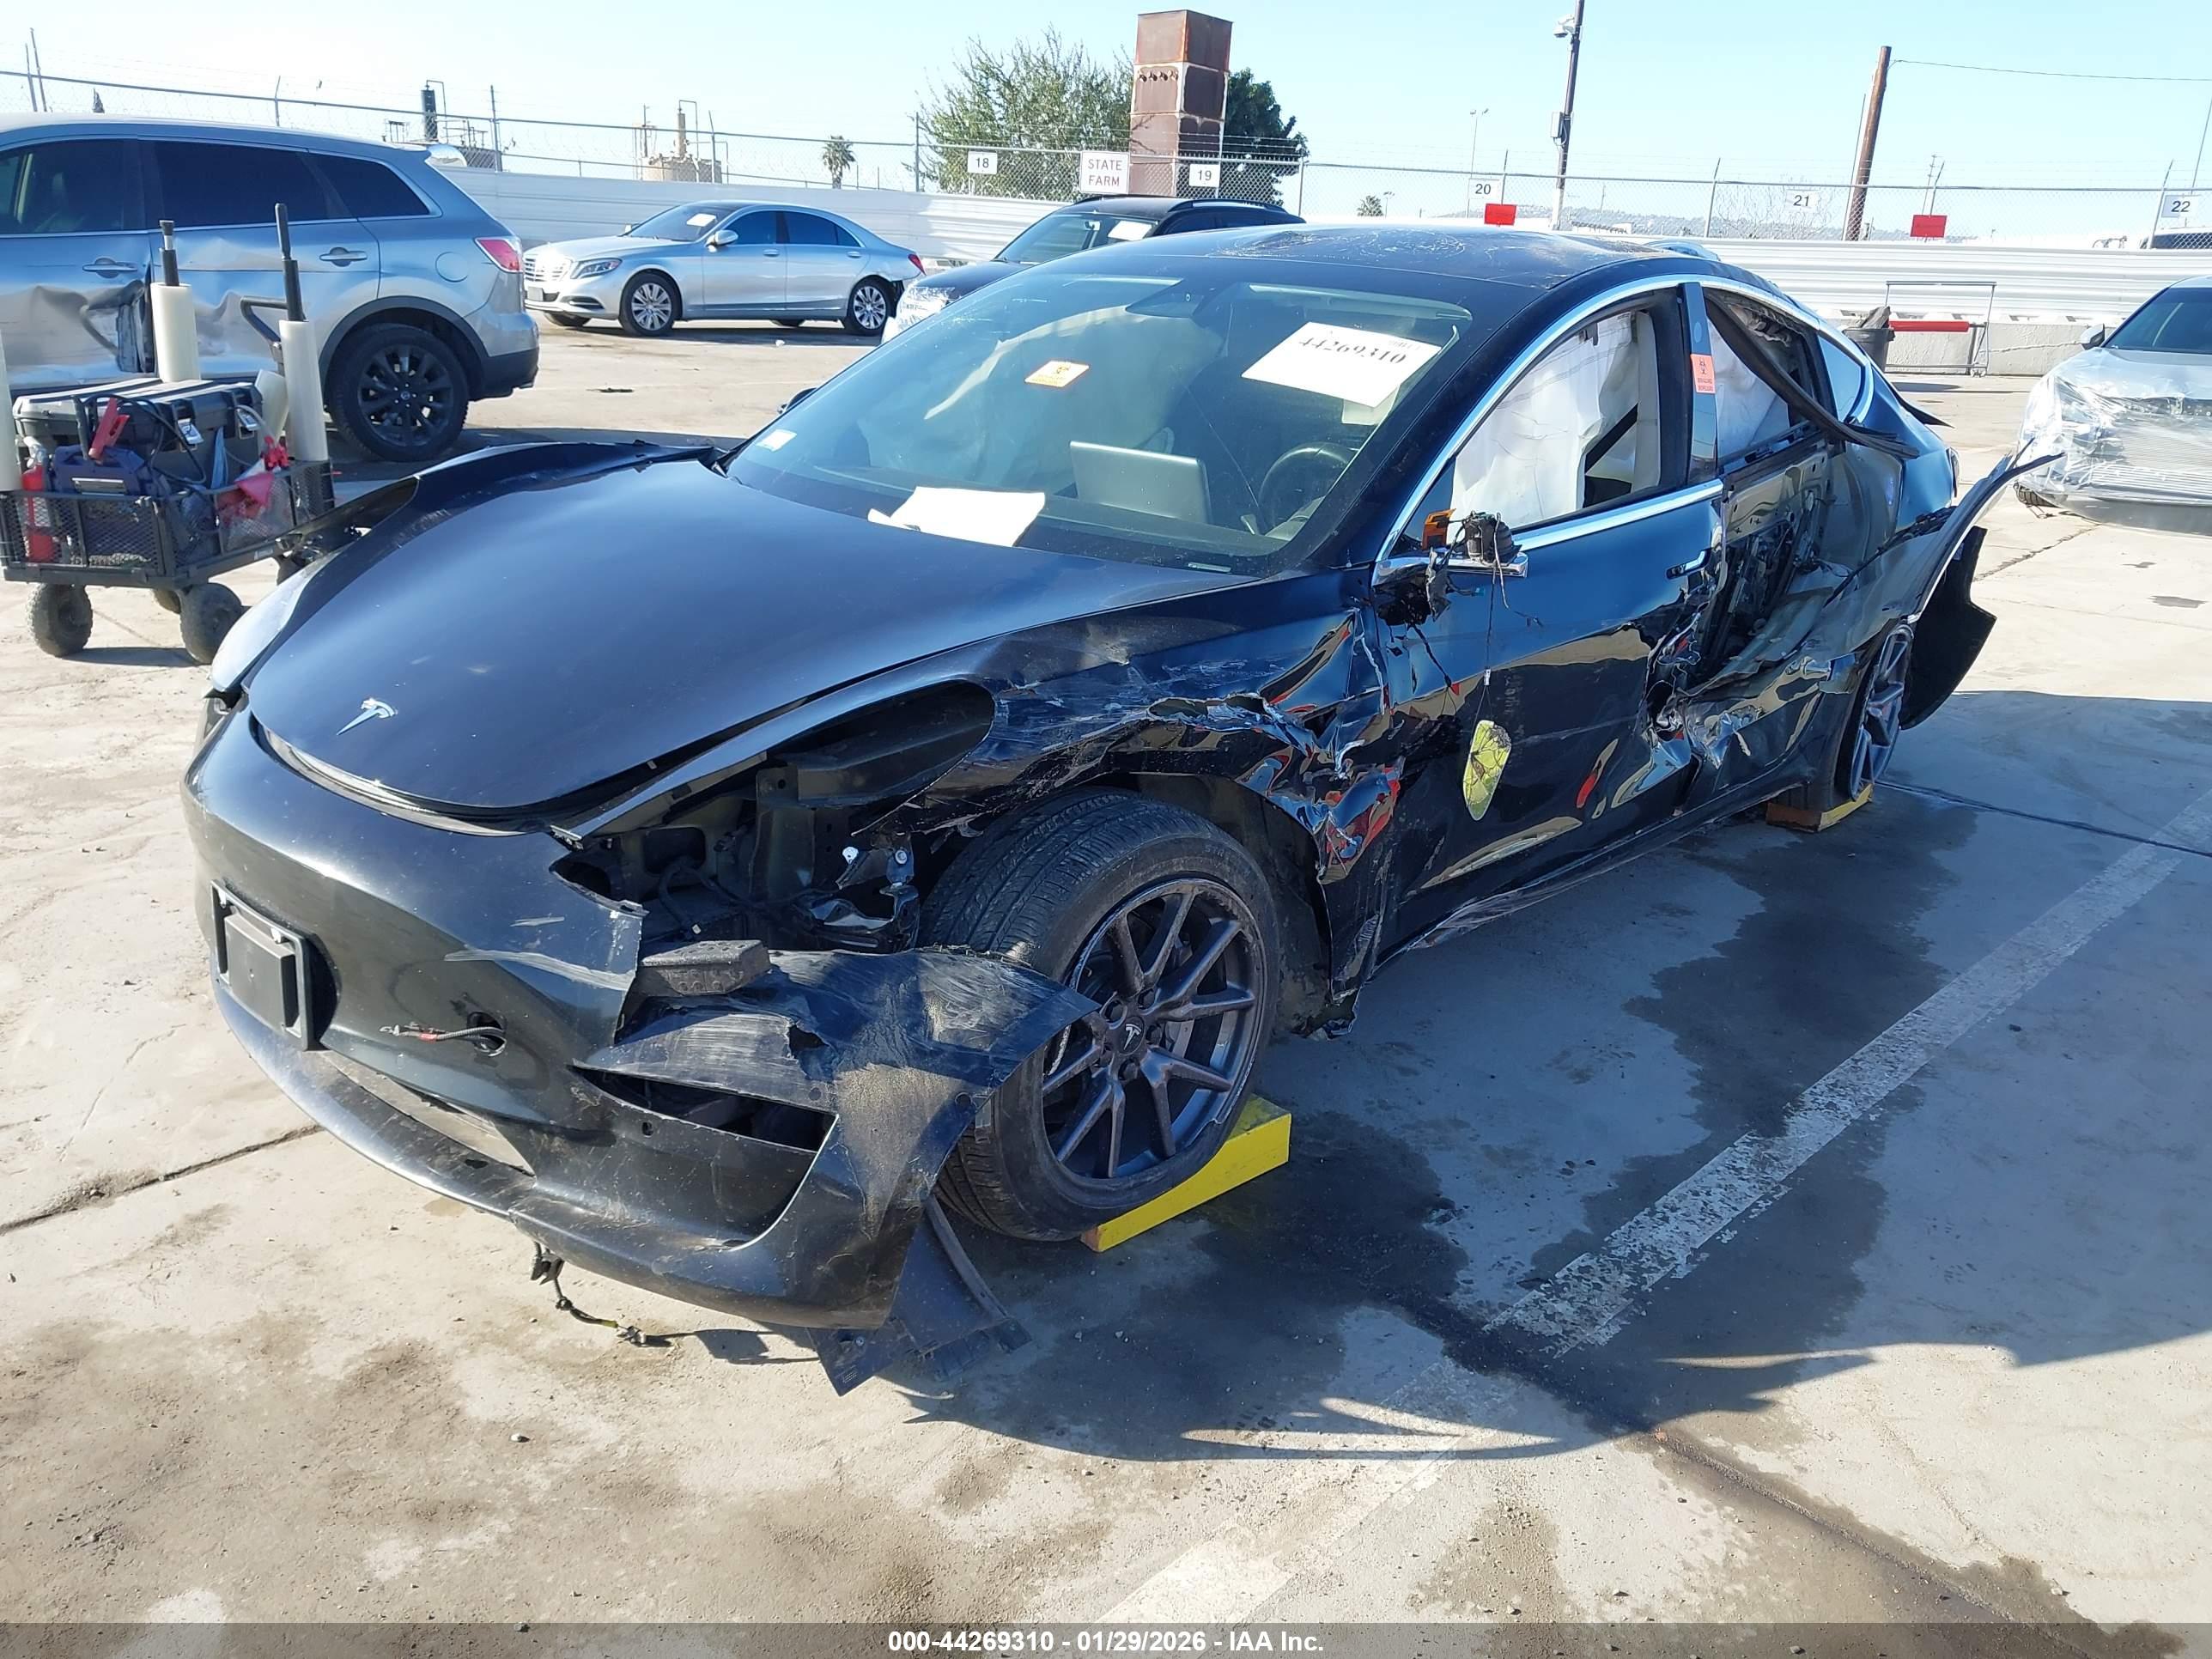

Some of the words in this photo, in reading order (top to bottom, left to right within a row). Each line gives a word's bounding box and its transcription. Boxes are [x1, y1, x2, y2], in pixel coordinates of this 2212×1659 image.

[975, 157, 989, 168] 18
[1087, 159, 1122, 171] STATE
[1088, 174, 1120, 186] FARM
[1197, 169, 1212, 181] 19
[1474, 183, 1492, 195] 20
[1793, 194, 1809, 207] 21
[2171, 200, 2191, 213] 22
